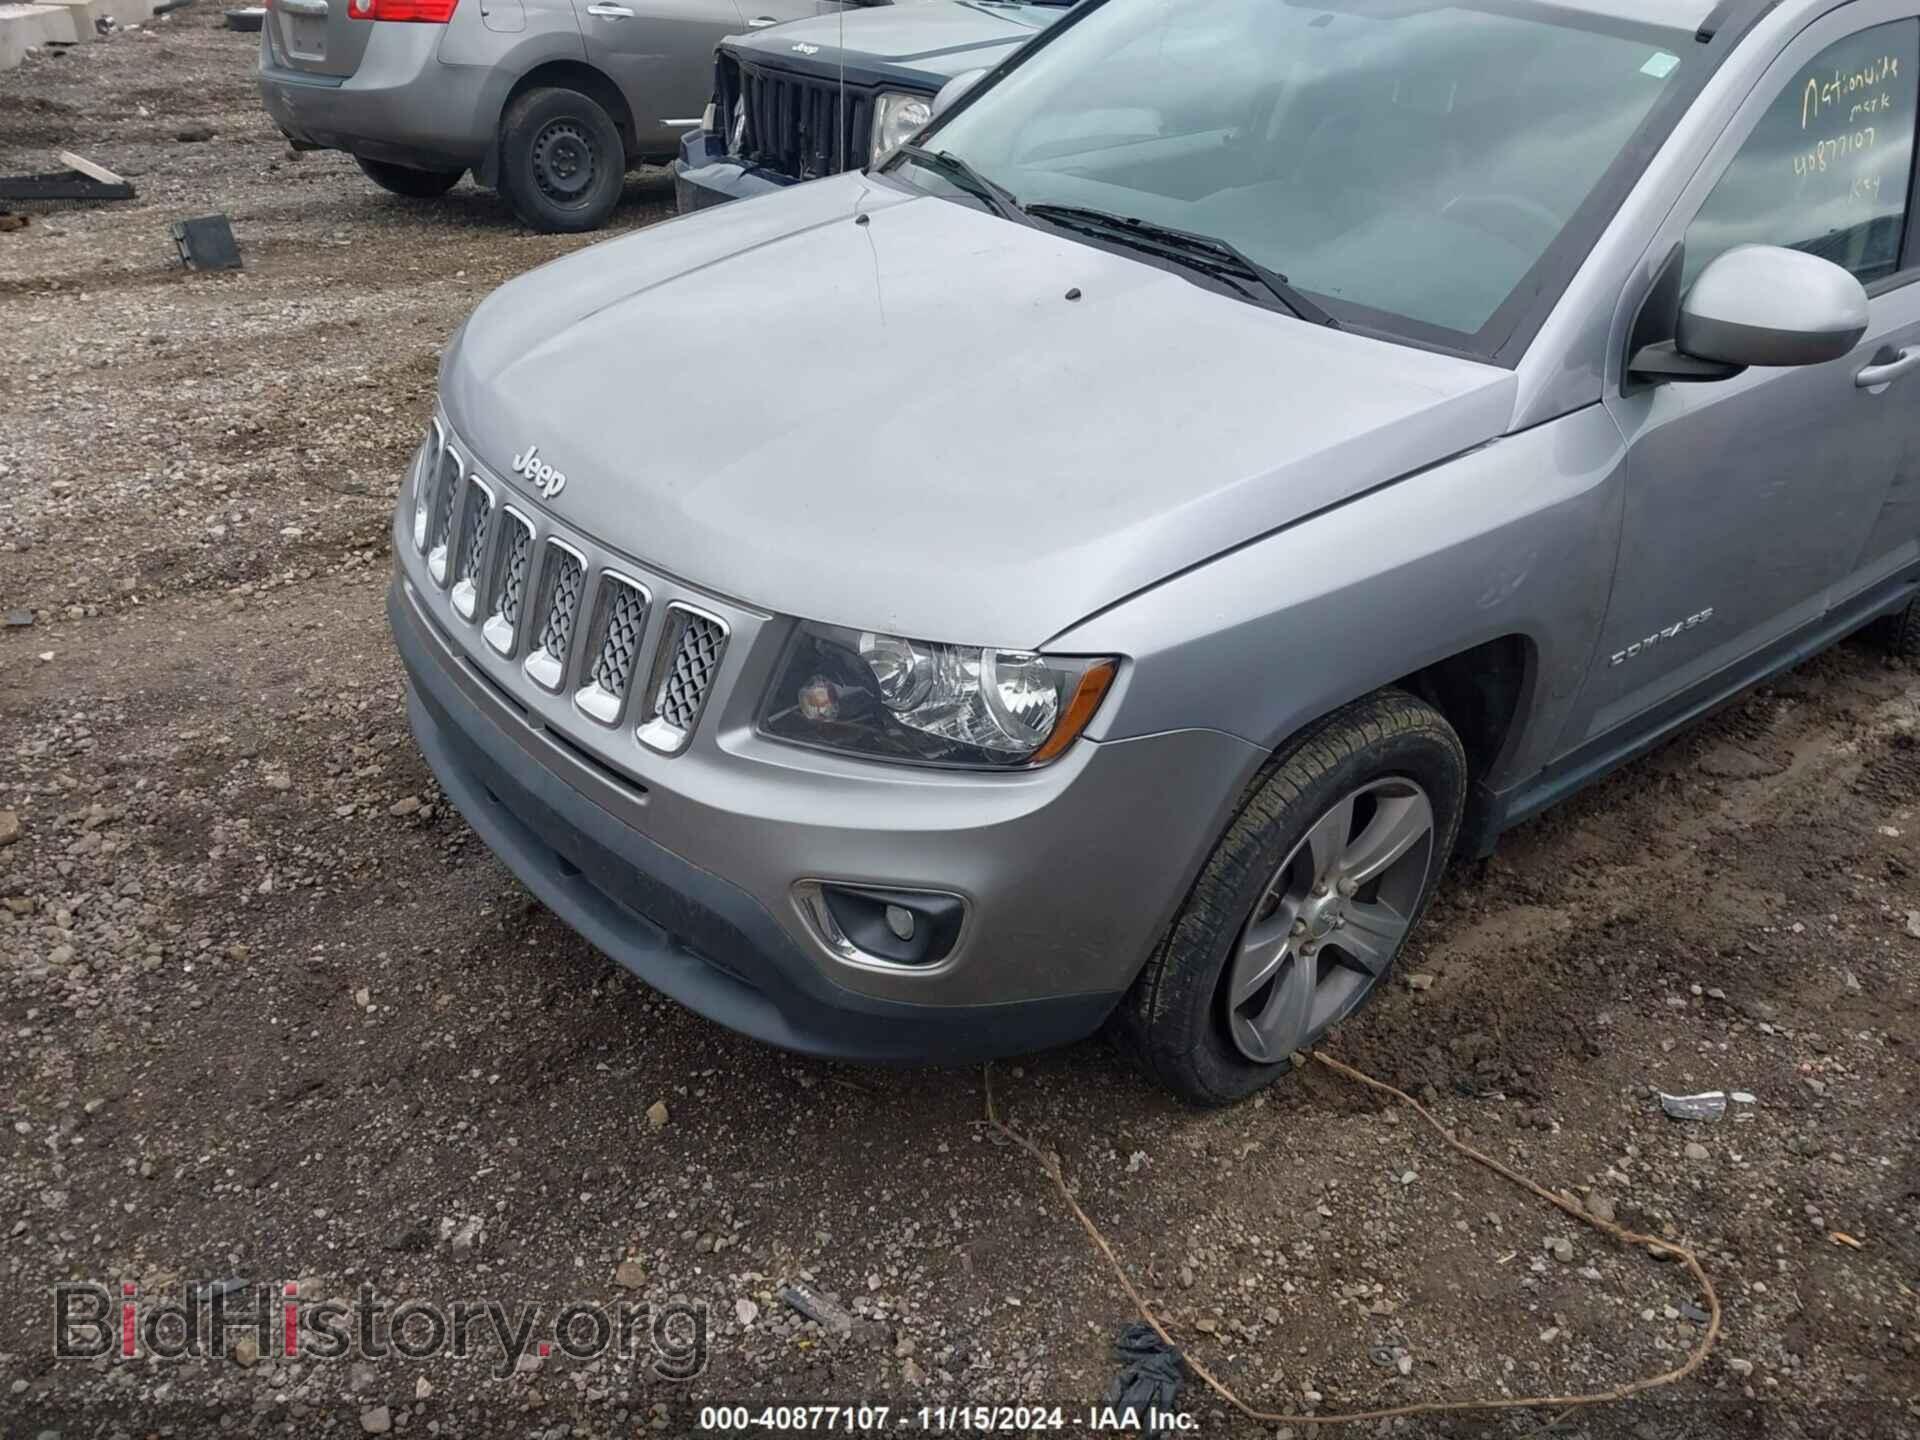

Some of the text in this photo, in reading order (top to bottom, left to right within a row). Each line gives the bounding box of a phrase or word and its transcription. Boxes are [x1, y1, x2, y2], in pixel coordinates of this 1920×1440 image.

[1794, 127, 1875, 176] 40877107
[512, 445, 566, 499] Jeep
[1611, 607, 1714, 665] COMPASS
